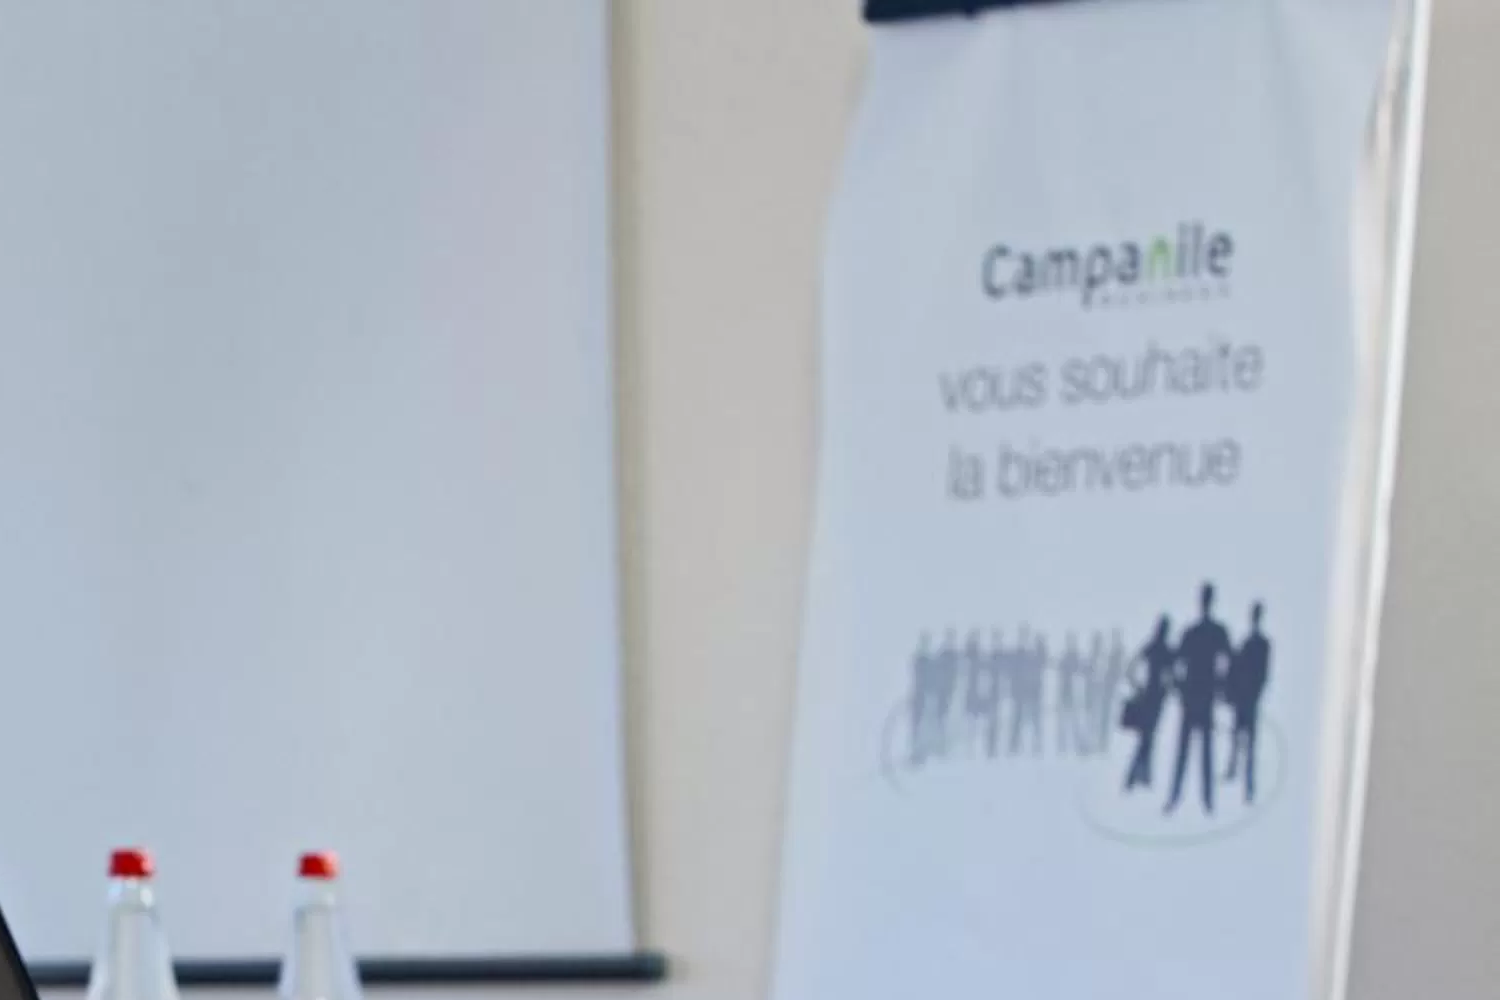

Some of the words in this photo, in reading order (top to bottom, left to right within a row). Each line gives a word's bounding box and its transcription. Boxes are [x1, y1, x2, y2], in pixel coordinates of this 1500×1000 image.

[980, 219, 1235, 311] Campanile
[937, 361, 1047, 414] vous
[1058, 338, 1266, 405] souhaite
[946, 443, 986, 500] la
[996, 436, 1245, 498] bienvenue
